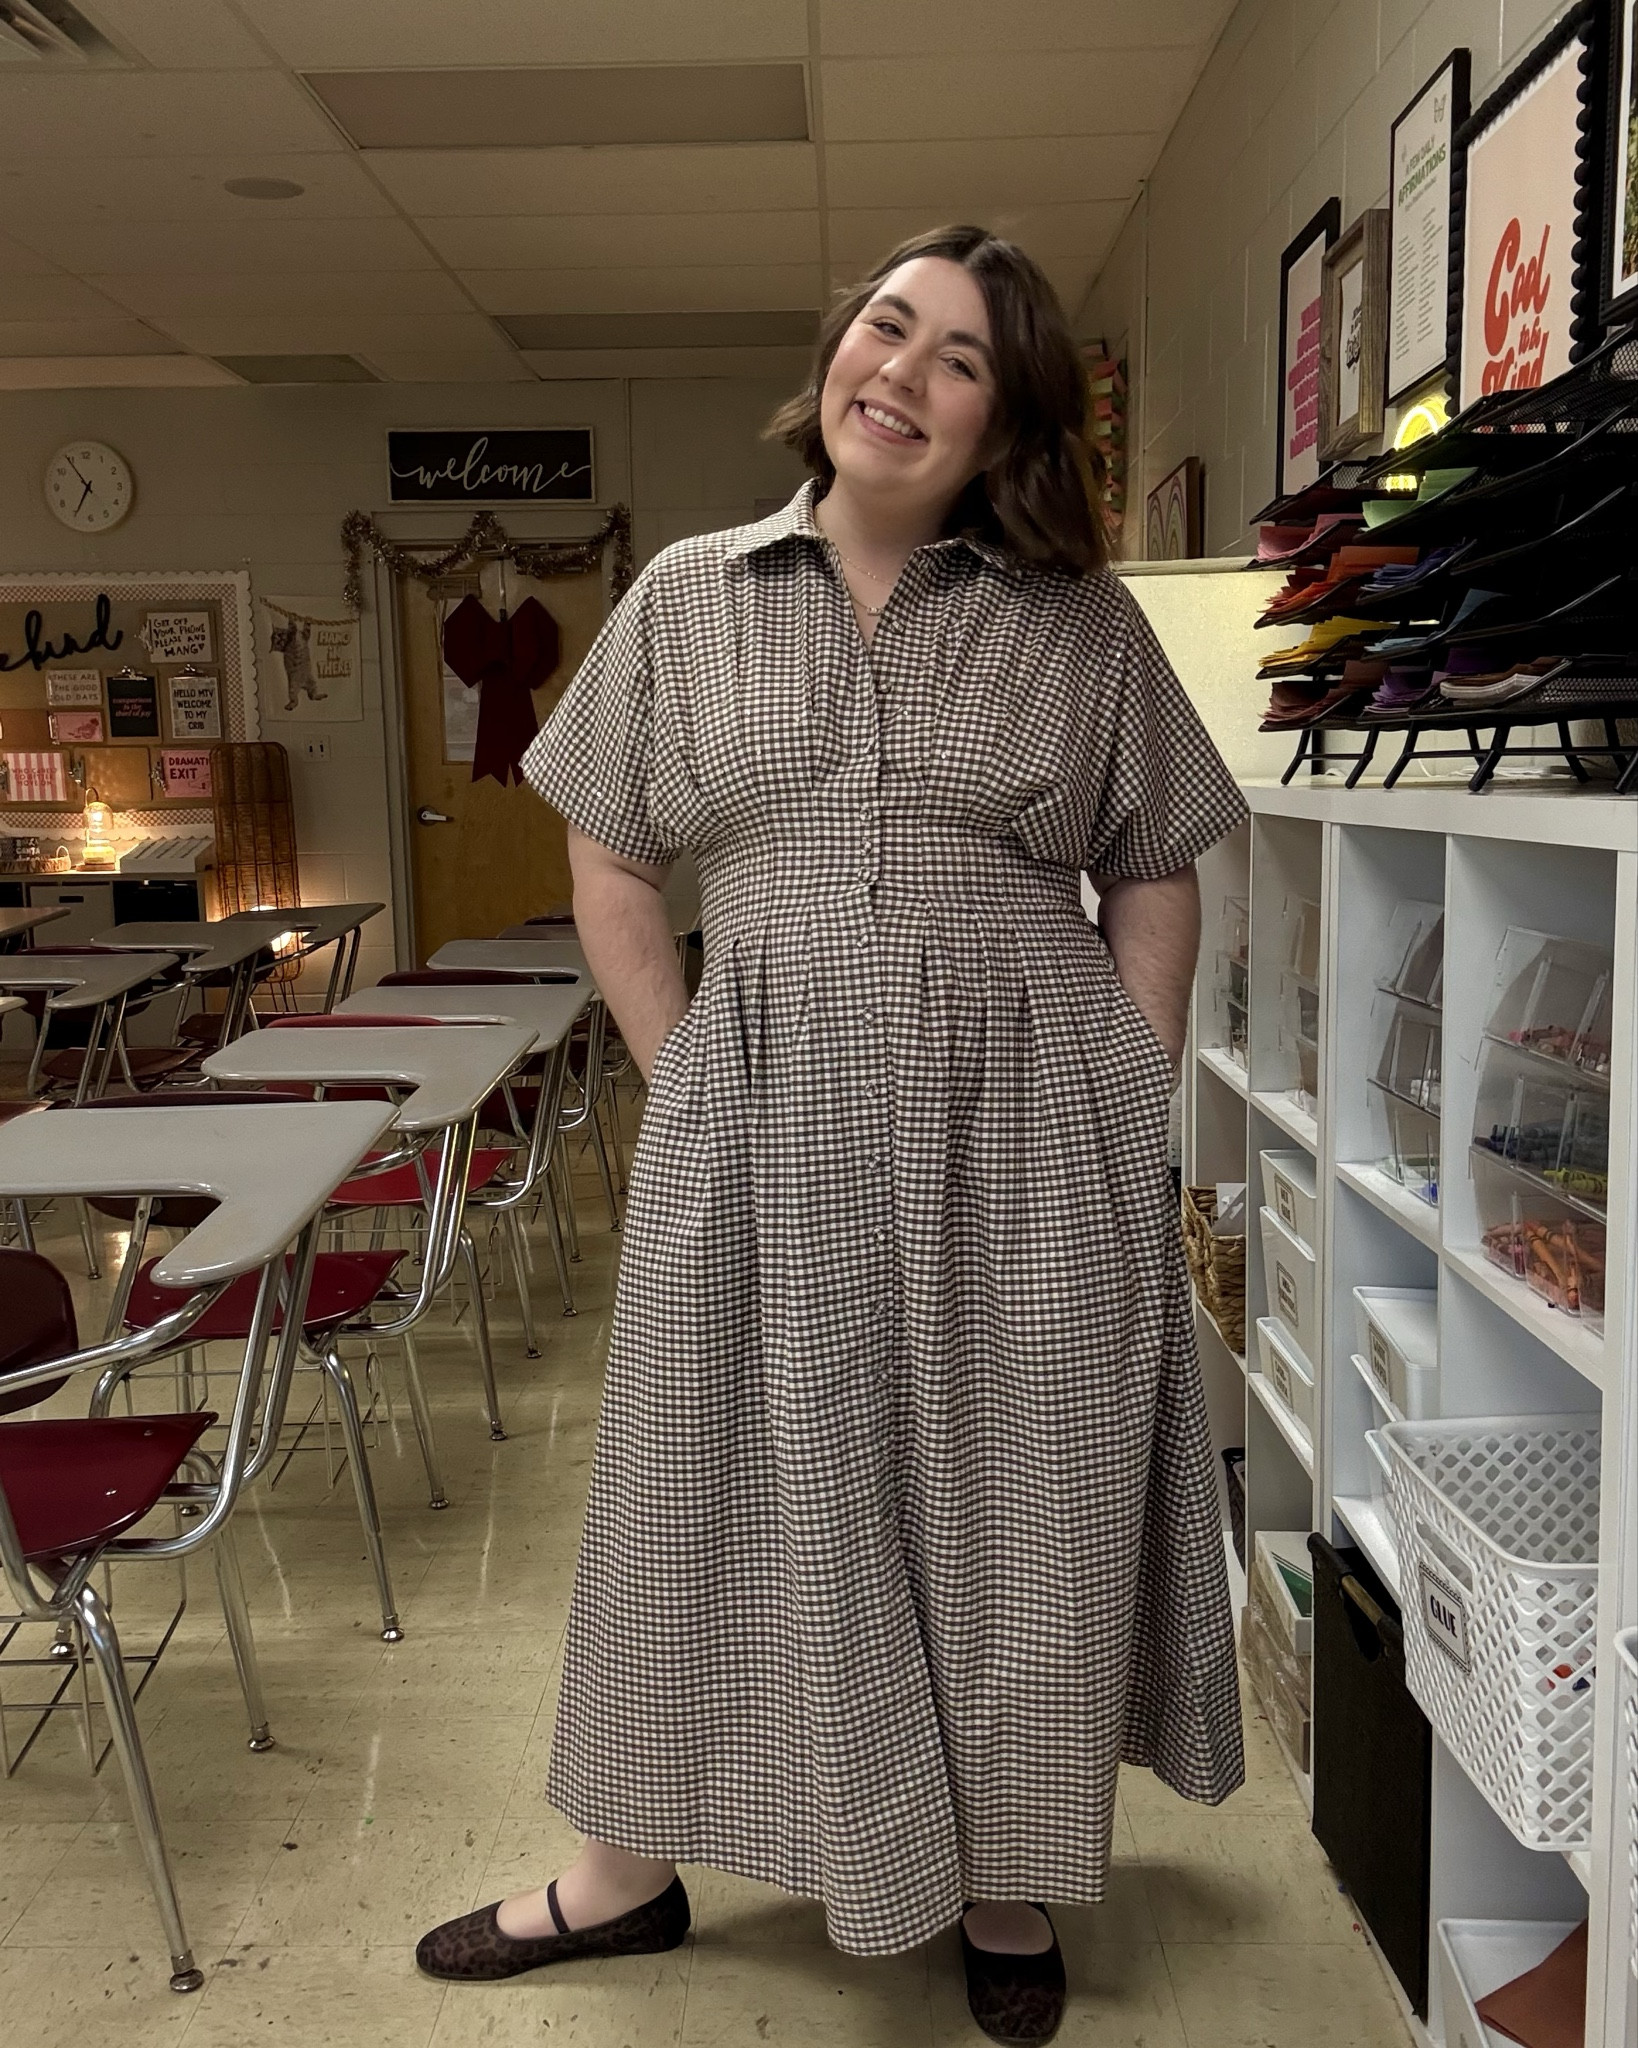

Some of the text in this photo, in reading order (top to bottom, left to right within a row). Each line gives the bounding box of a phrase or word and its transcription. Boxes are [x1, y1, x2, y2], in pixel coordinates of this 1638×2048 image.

[1484, 217, 1551, 356] Cool
[1518, 323, 1530, 356] to
[81, 451, 91, 460] 12
[389, 436, 592, 493] welcome
[57, 466, 117, 476] 10 2
[53, 482, 123, 492] 9 3
[112, 498, 119, 506] 4
[87, 509, 110, 522] 6 5
[153, 618, 170, 628] GET
[24, 593, 124, 672] kind
[153, 623, 206, 639] YOUR PHONE
[154, 634, 206, 648] PLEASE AND
[317, 630, 352, 647] HANG
[164, 643, 199, 658] HANG
[80, 673, 97, 681] ARE
[53, 693, 72, 701] OLD
[173, 689, 214, 698] HELLO MTV
[177, 700, 212, 709] WELCOME
[184, 710, 208, 719] TO MY
[188, 721, 205, 730] CRIB
[168, 756, 209, 766] DRAMATI
[170, 768, 198, 779] EXIT
[1430, 1594, 1458, 1639] GLUE
